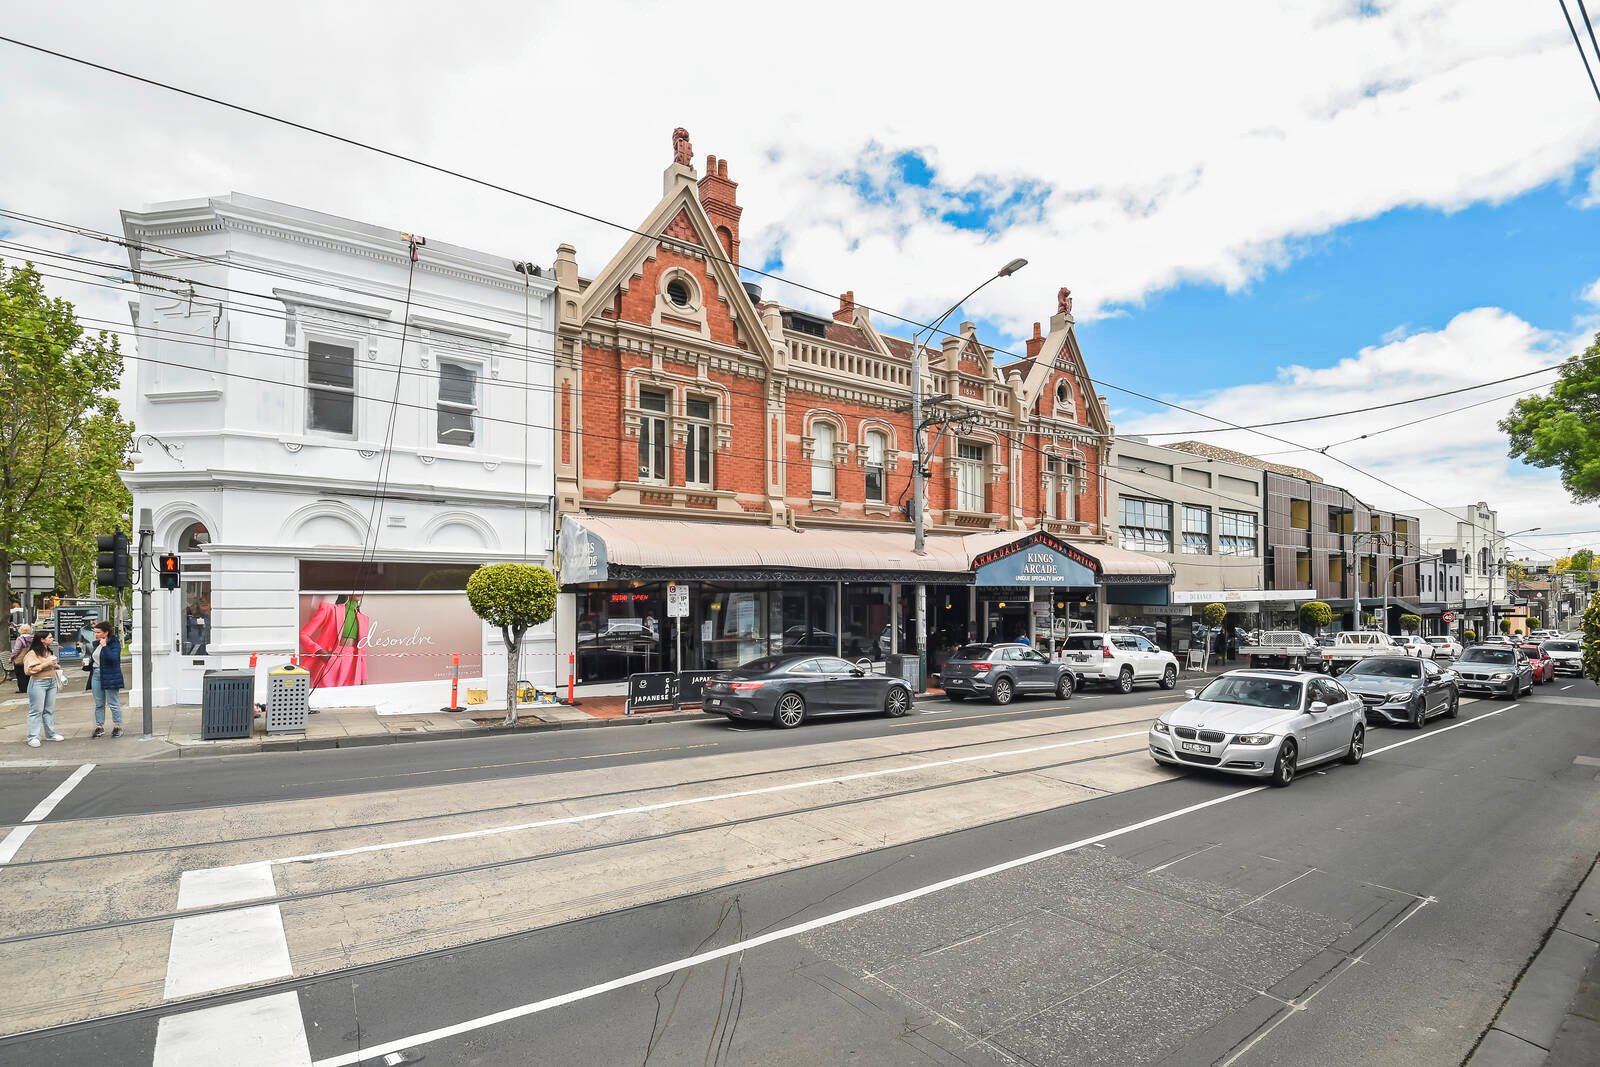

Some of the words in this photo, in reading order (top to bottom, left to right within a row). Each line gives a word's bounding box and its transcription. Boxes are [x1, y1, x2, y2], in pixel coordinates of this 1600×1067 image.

[1027, 553, 1054, 563] KINGS
[1067, 548, 1098, 571] STATION
[1023, 564, 1058, 574] ARCADE
[356, 620, 435, 649] désordre
[634, 694, 669, 704] JAPANESE
